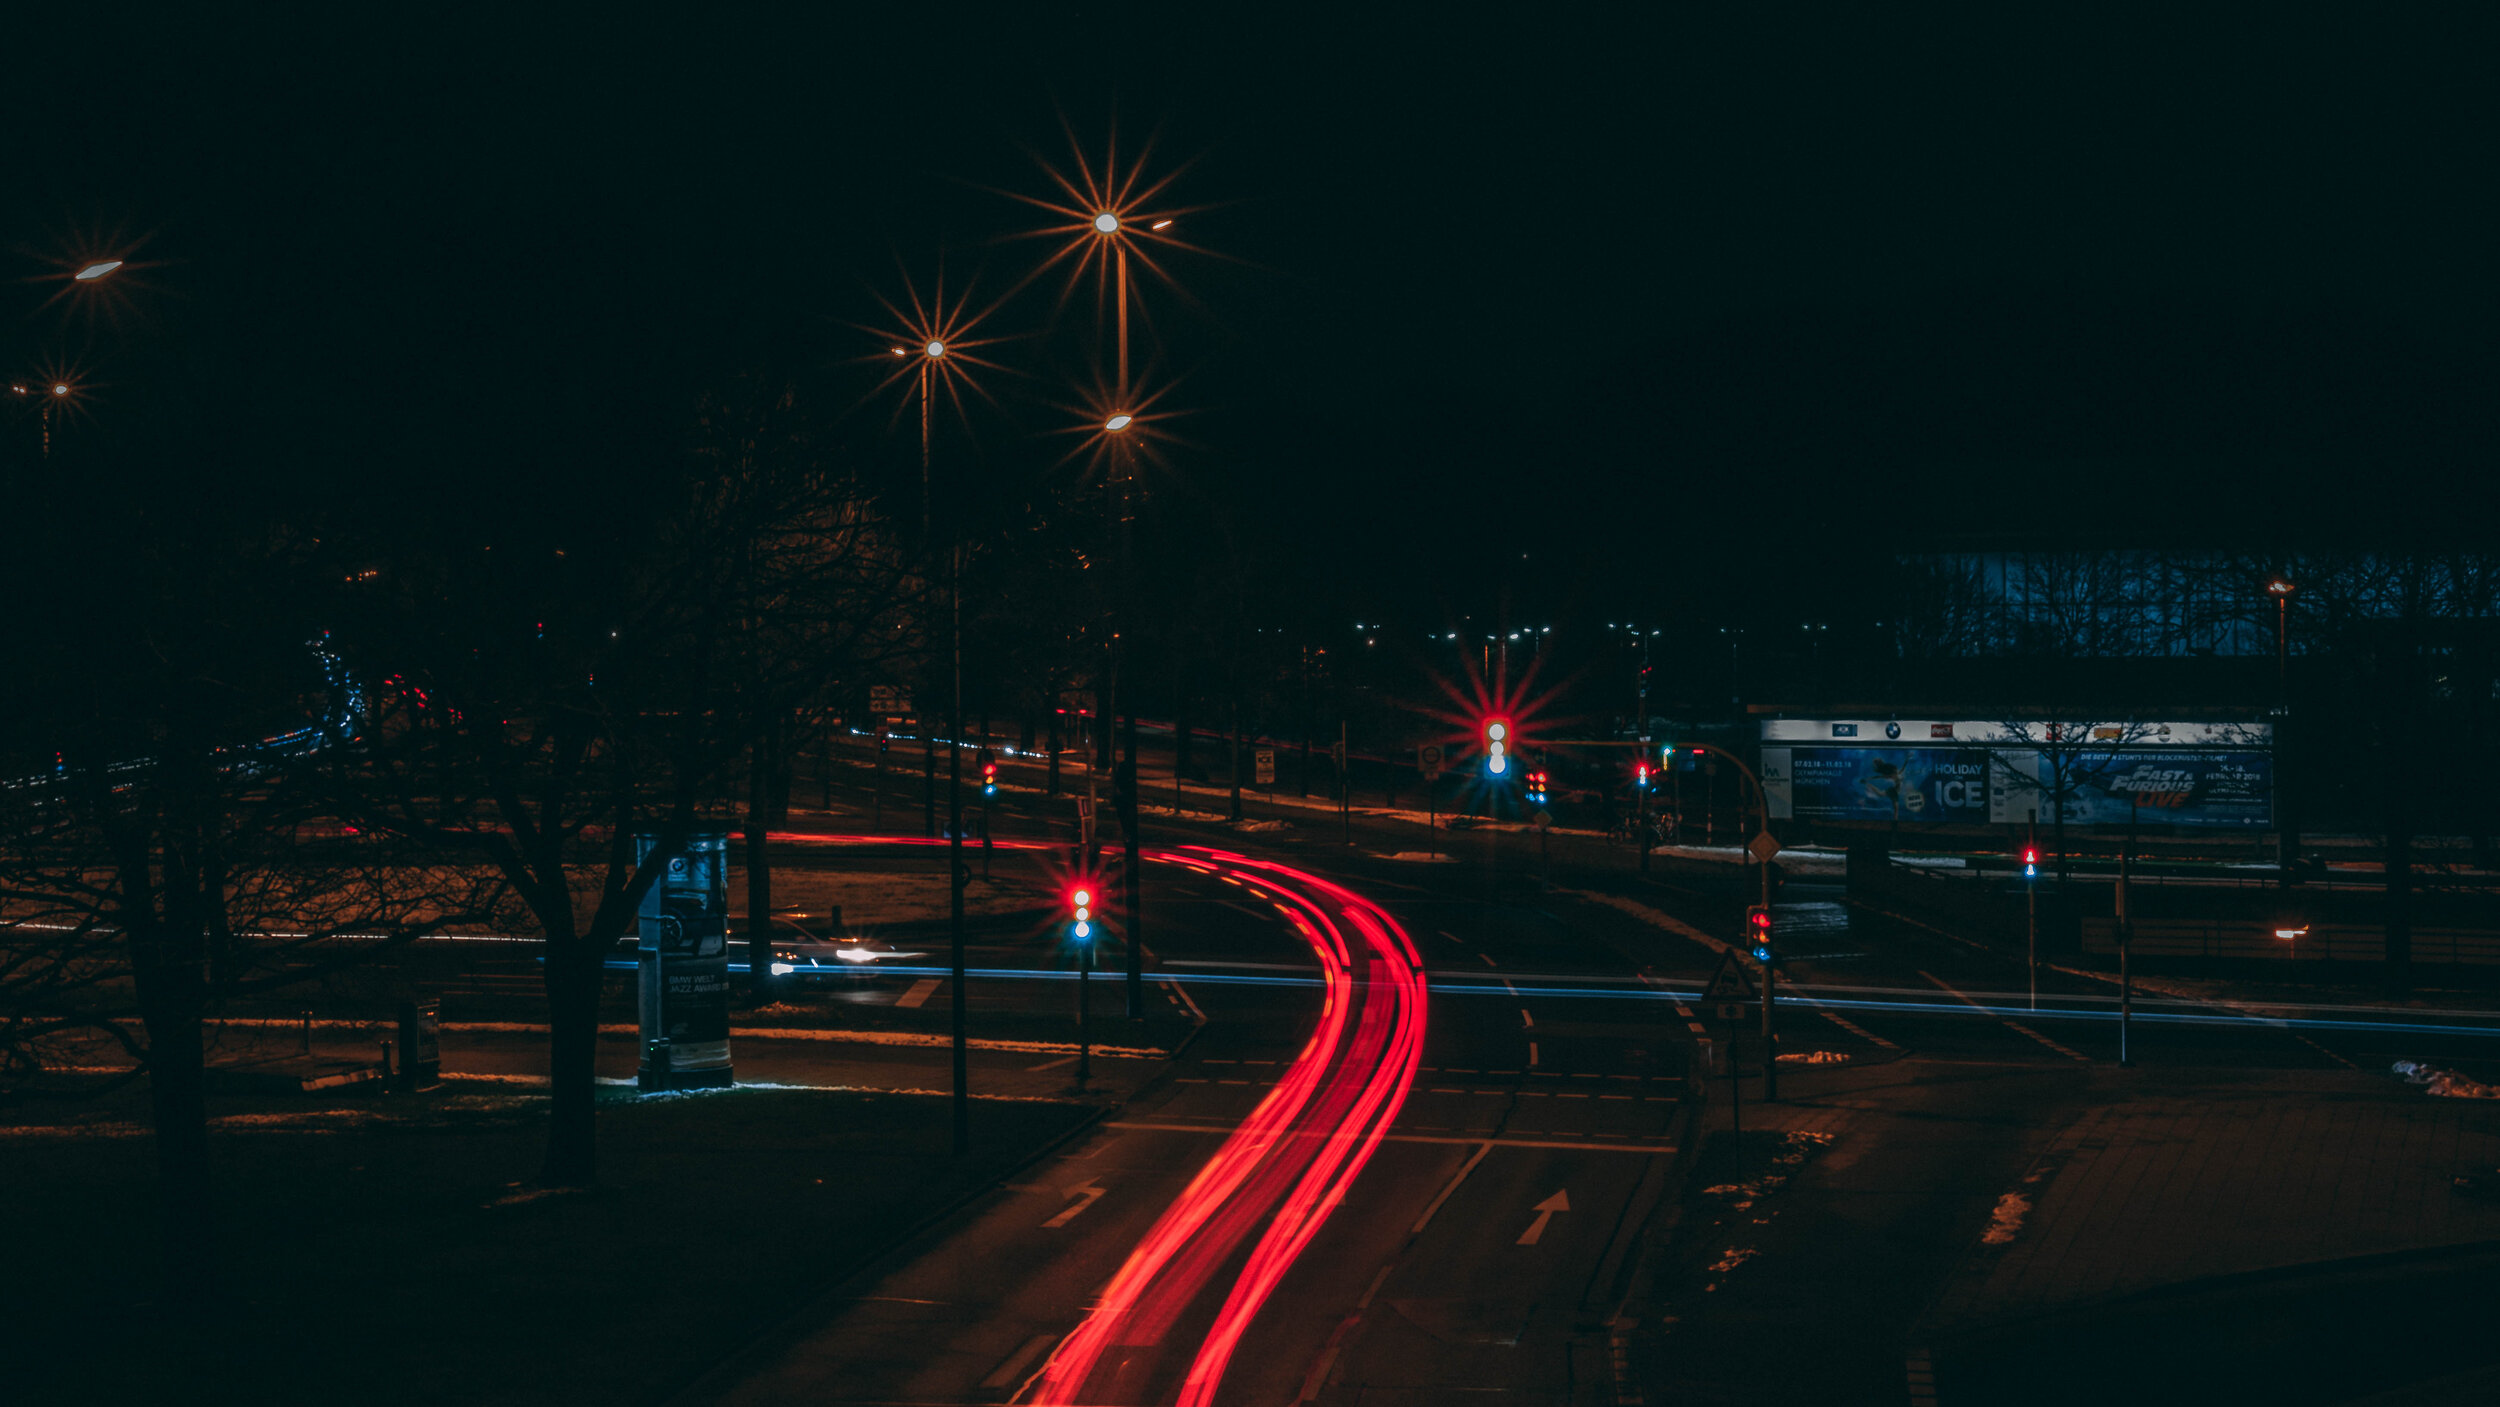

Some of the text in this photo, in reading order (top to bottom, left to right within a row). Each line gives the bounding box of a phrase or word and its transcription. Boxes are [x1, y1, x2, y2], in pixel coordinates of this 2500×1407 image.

[1935, 763, 1983, 775] HOLIDAY
[2132, 765, 2185, 781] FAST
[2109, 775, 2195, 792] FURIOUS
[1935, 780, 1985, 808] ICE
[2135, 791, 2190, 808] LIVE
[671, 984, 692, 993] JAZZ
